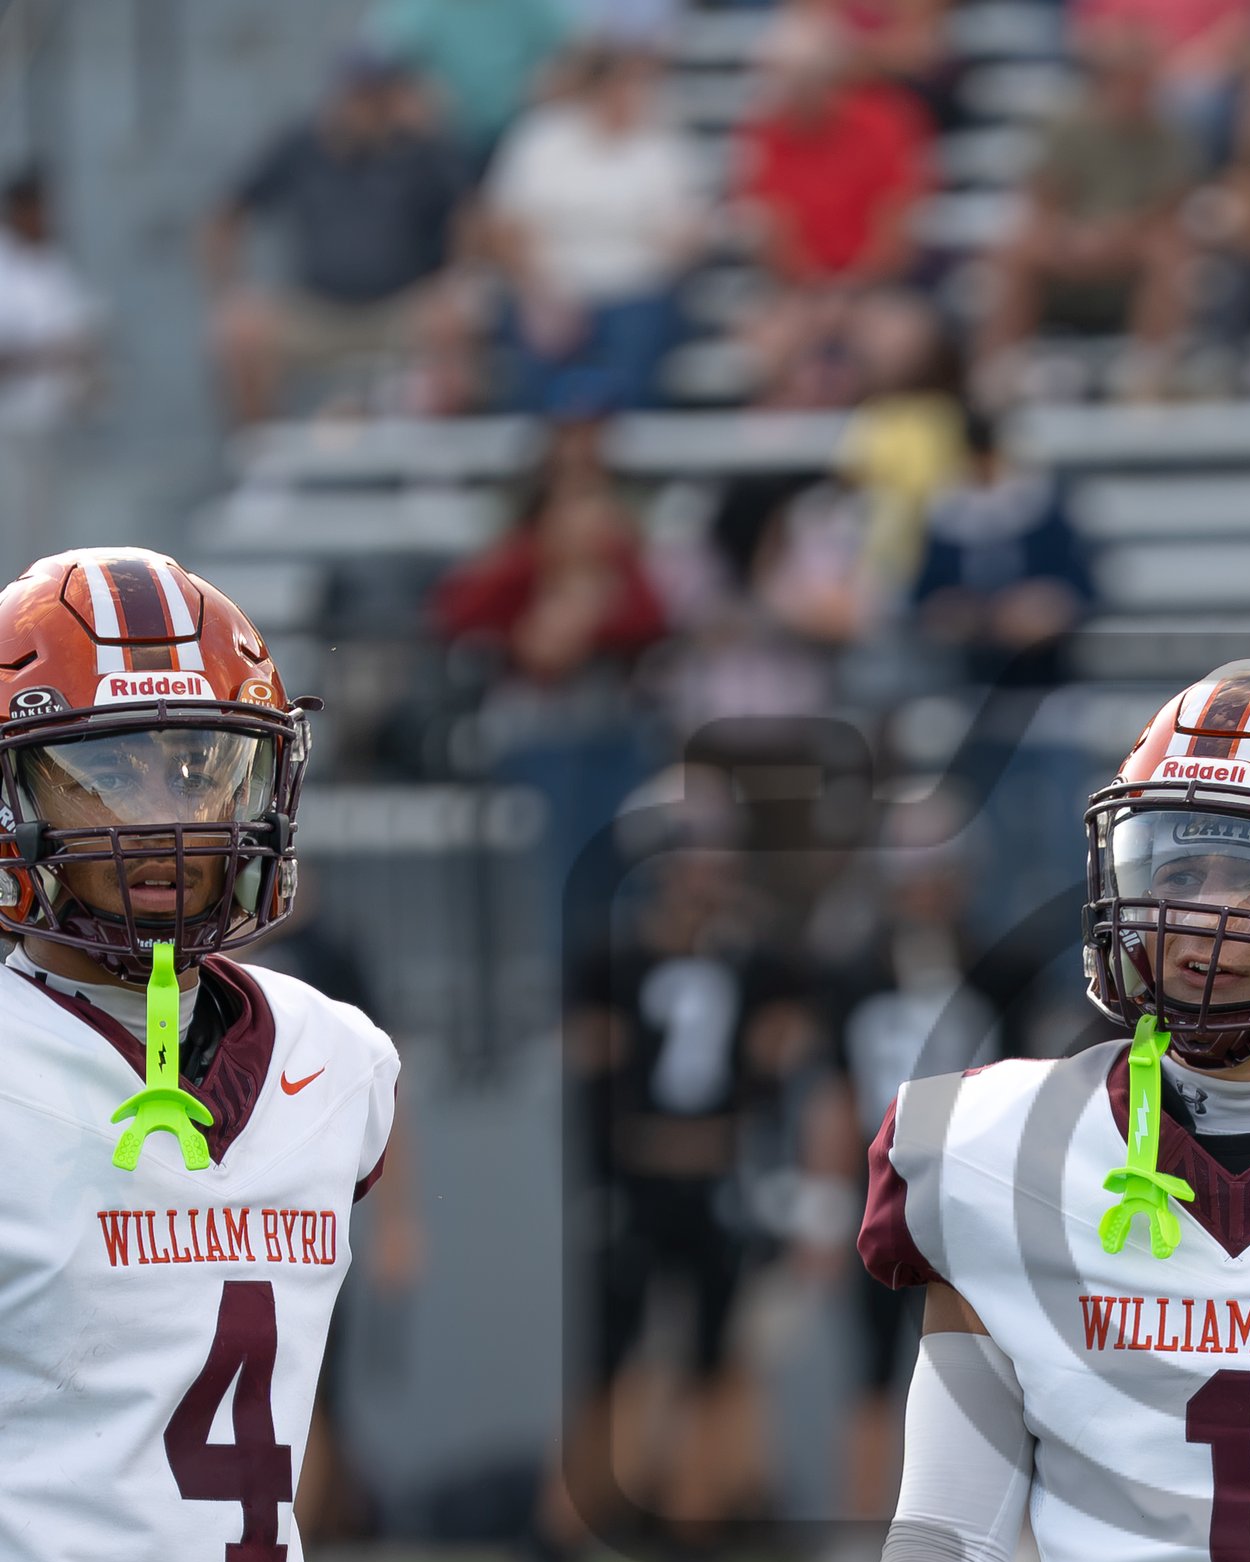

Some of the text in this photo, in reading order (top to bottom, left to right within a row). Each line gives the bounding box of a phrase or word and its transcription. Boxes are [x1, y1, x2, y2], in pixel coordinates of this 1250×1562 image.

[110, 677, 202, 697] Riddell
[1163, 761, 1246, 783] Riddell
[97, 1208, 337, 1267] WILLIAM BYRD
